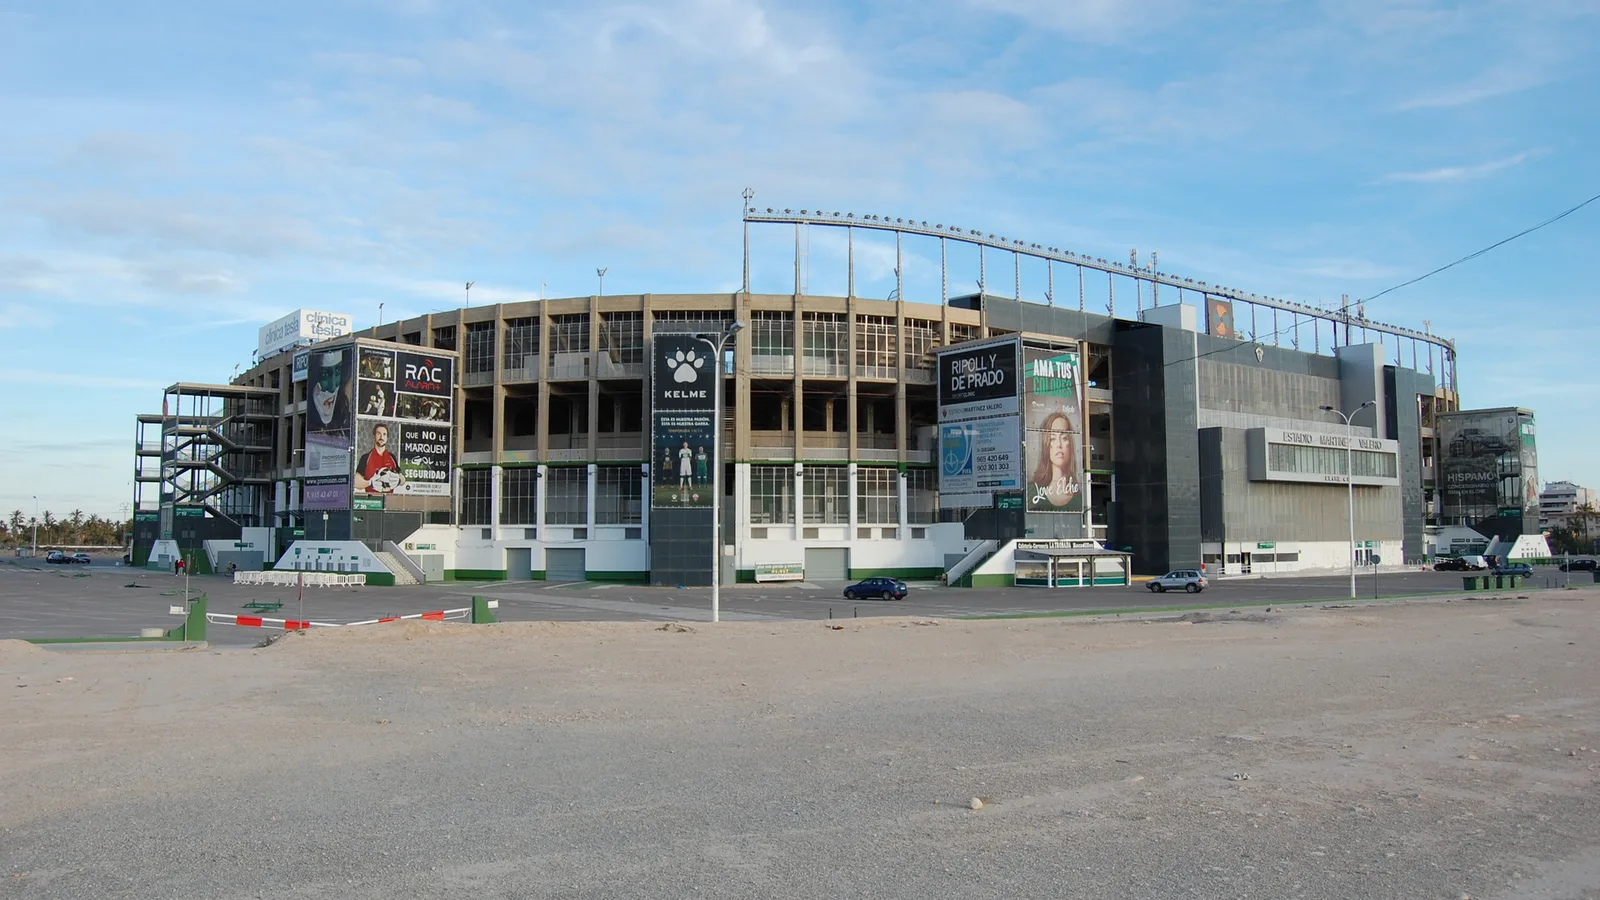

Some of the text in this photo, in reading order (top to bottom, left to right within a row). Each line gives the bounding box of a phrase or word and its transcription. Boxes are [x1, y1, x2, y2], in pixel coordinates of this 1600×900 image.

[284, 317, 299, 336] tesla
[311, 323, 342, 337] tesla
[405, 363, 442, 383] RAC
[951, 353, 997, 375] RIPOLL Y
[1033, 358, 1072, 380] AMA TUS
[951, 369, 1004, 391] DE PRADO
[1033, 377, 1073, 398] COLORES
[664, 390, 707, 398] KELME
[405, 430, 446, 442] QUE NO LE
[1283, 431, 1312, 444] ESTADIO
[1358, 439, 1382, 450] VALERO
[404, 442, 447, 454] MARQUEN
[976, 455, 987, 463] 965
[987, 454, 998, 462] 420
[976, 462, 1009, 472] 902 301 303
[404, 469, 446, 480] SEGURIDAD
[1032, 476, 1079, 504] Love Elche
